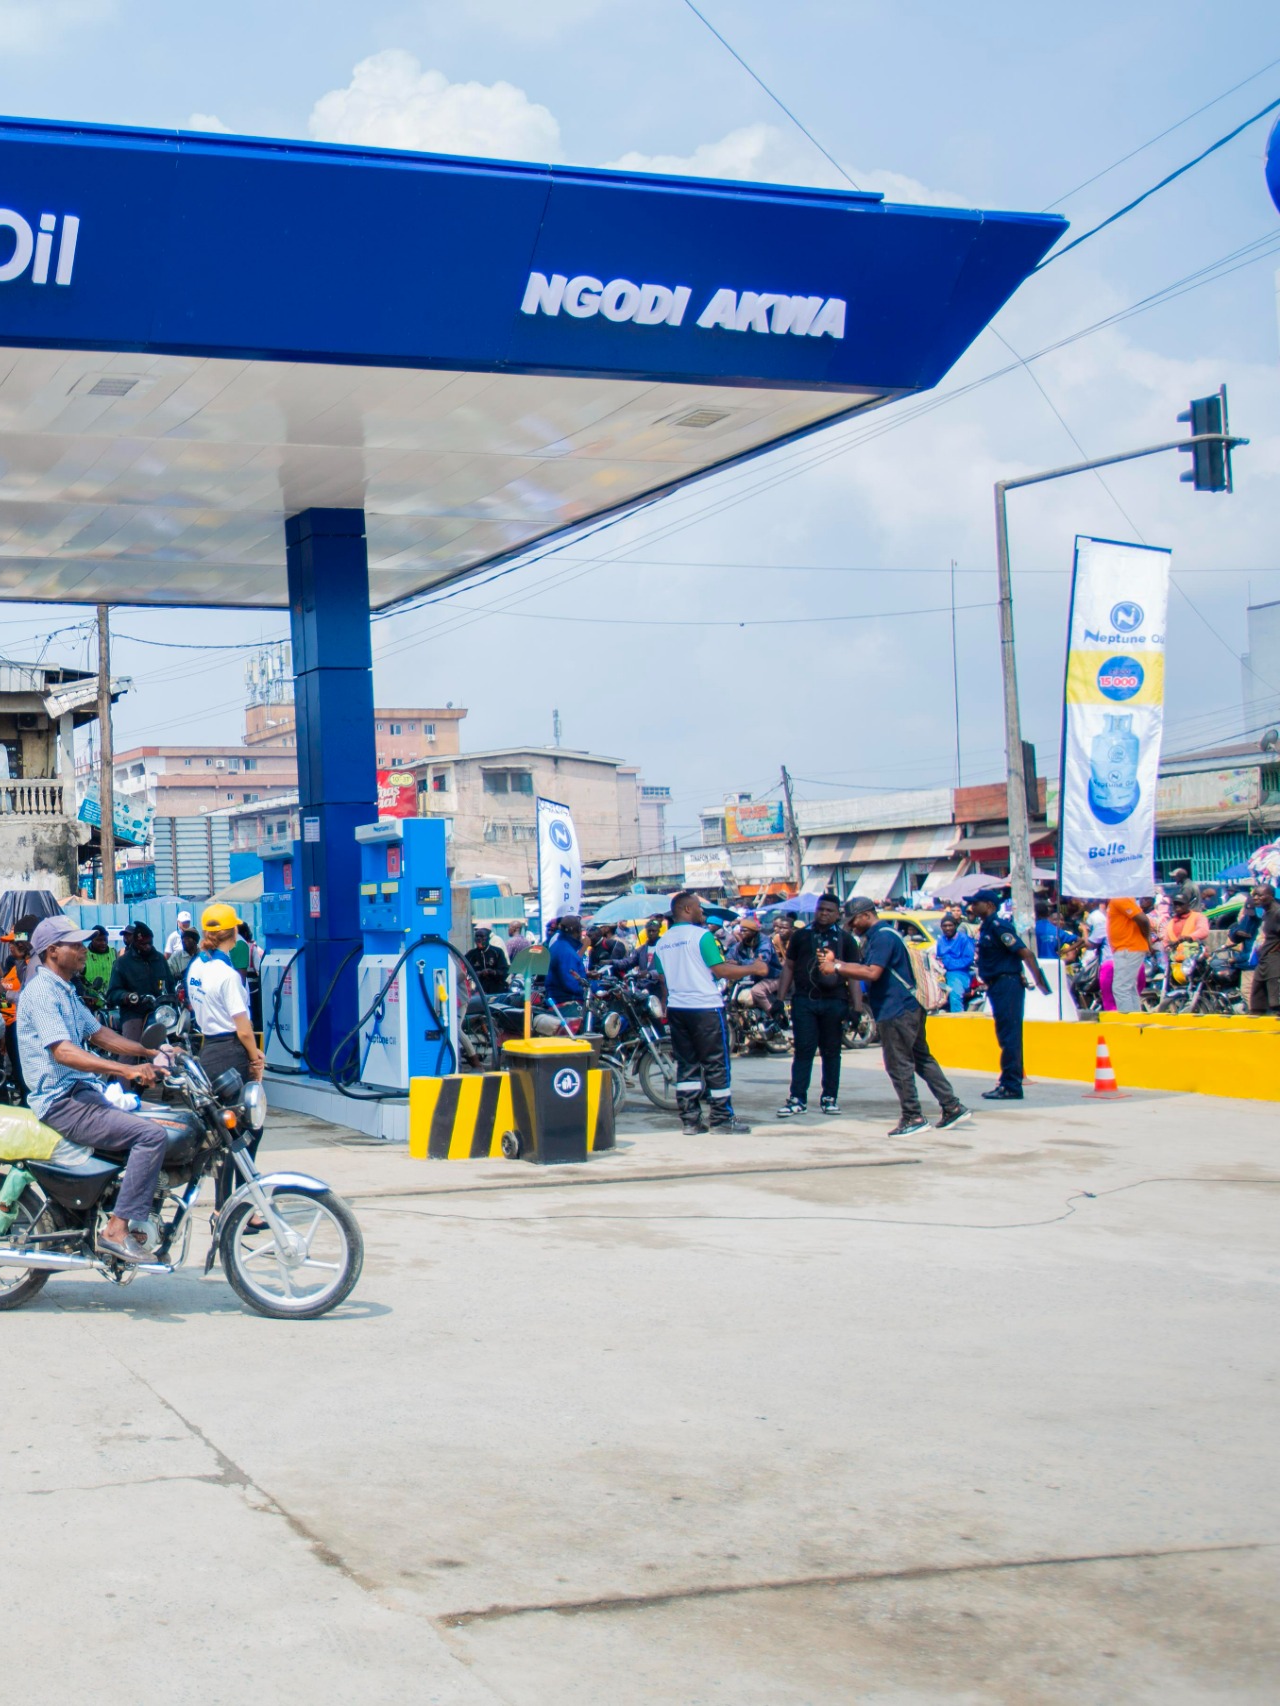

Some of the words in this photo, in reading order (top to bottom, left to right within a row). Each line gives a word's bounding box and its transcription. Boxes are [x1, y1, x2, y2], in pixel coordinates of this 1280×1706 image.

[520, 271, 693, 327] NGODI
[695, 287, 847, 339] AKWA
[1083, 628, 1147, 645] Neptune
[1099, 676, 1112, 687] 15
[1113, 676, 1138, 688] 000
[1087, 842, 1126, 860] Belle
